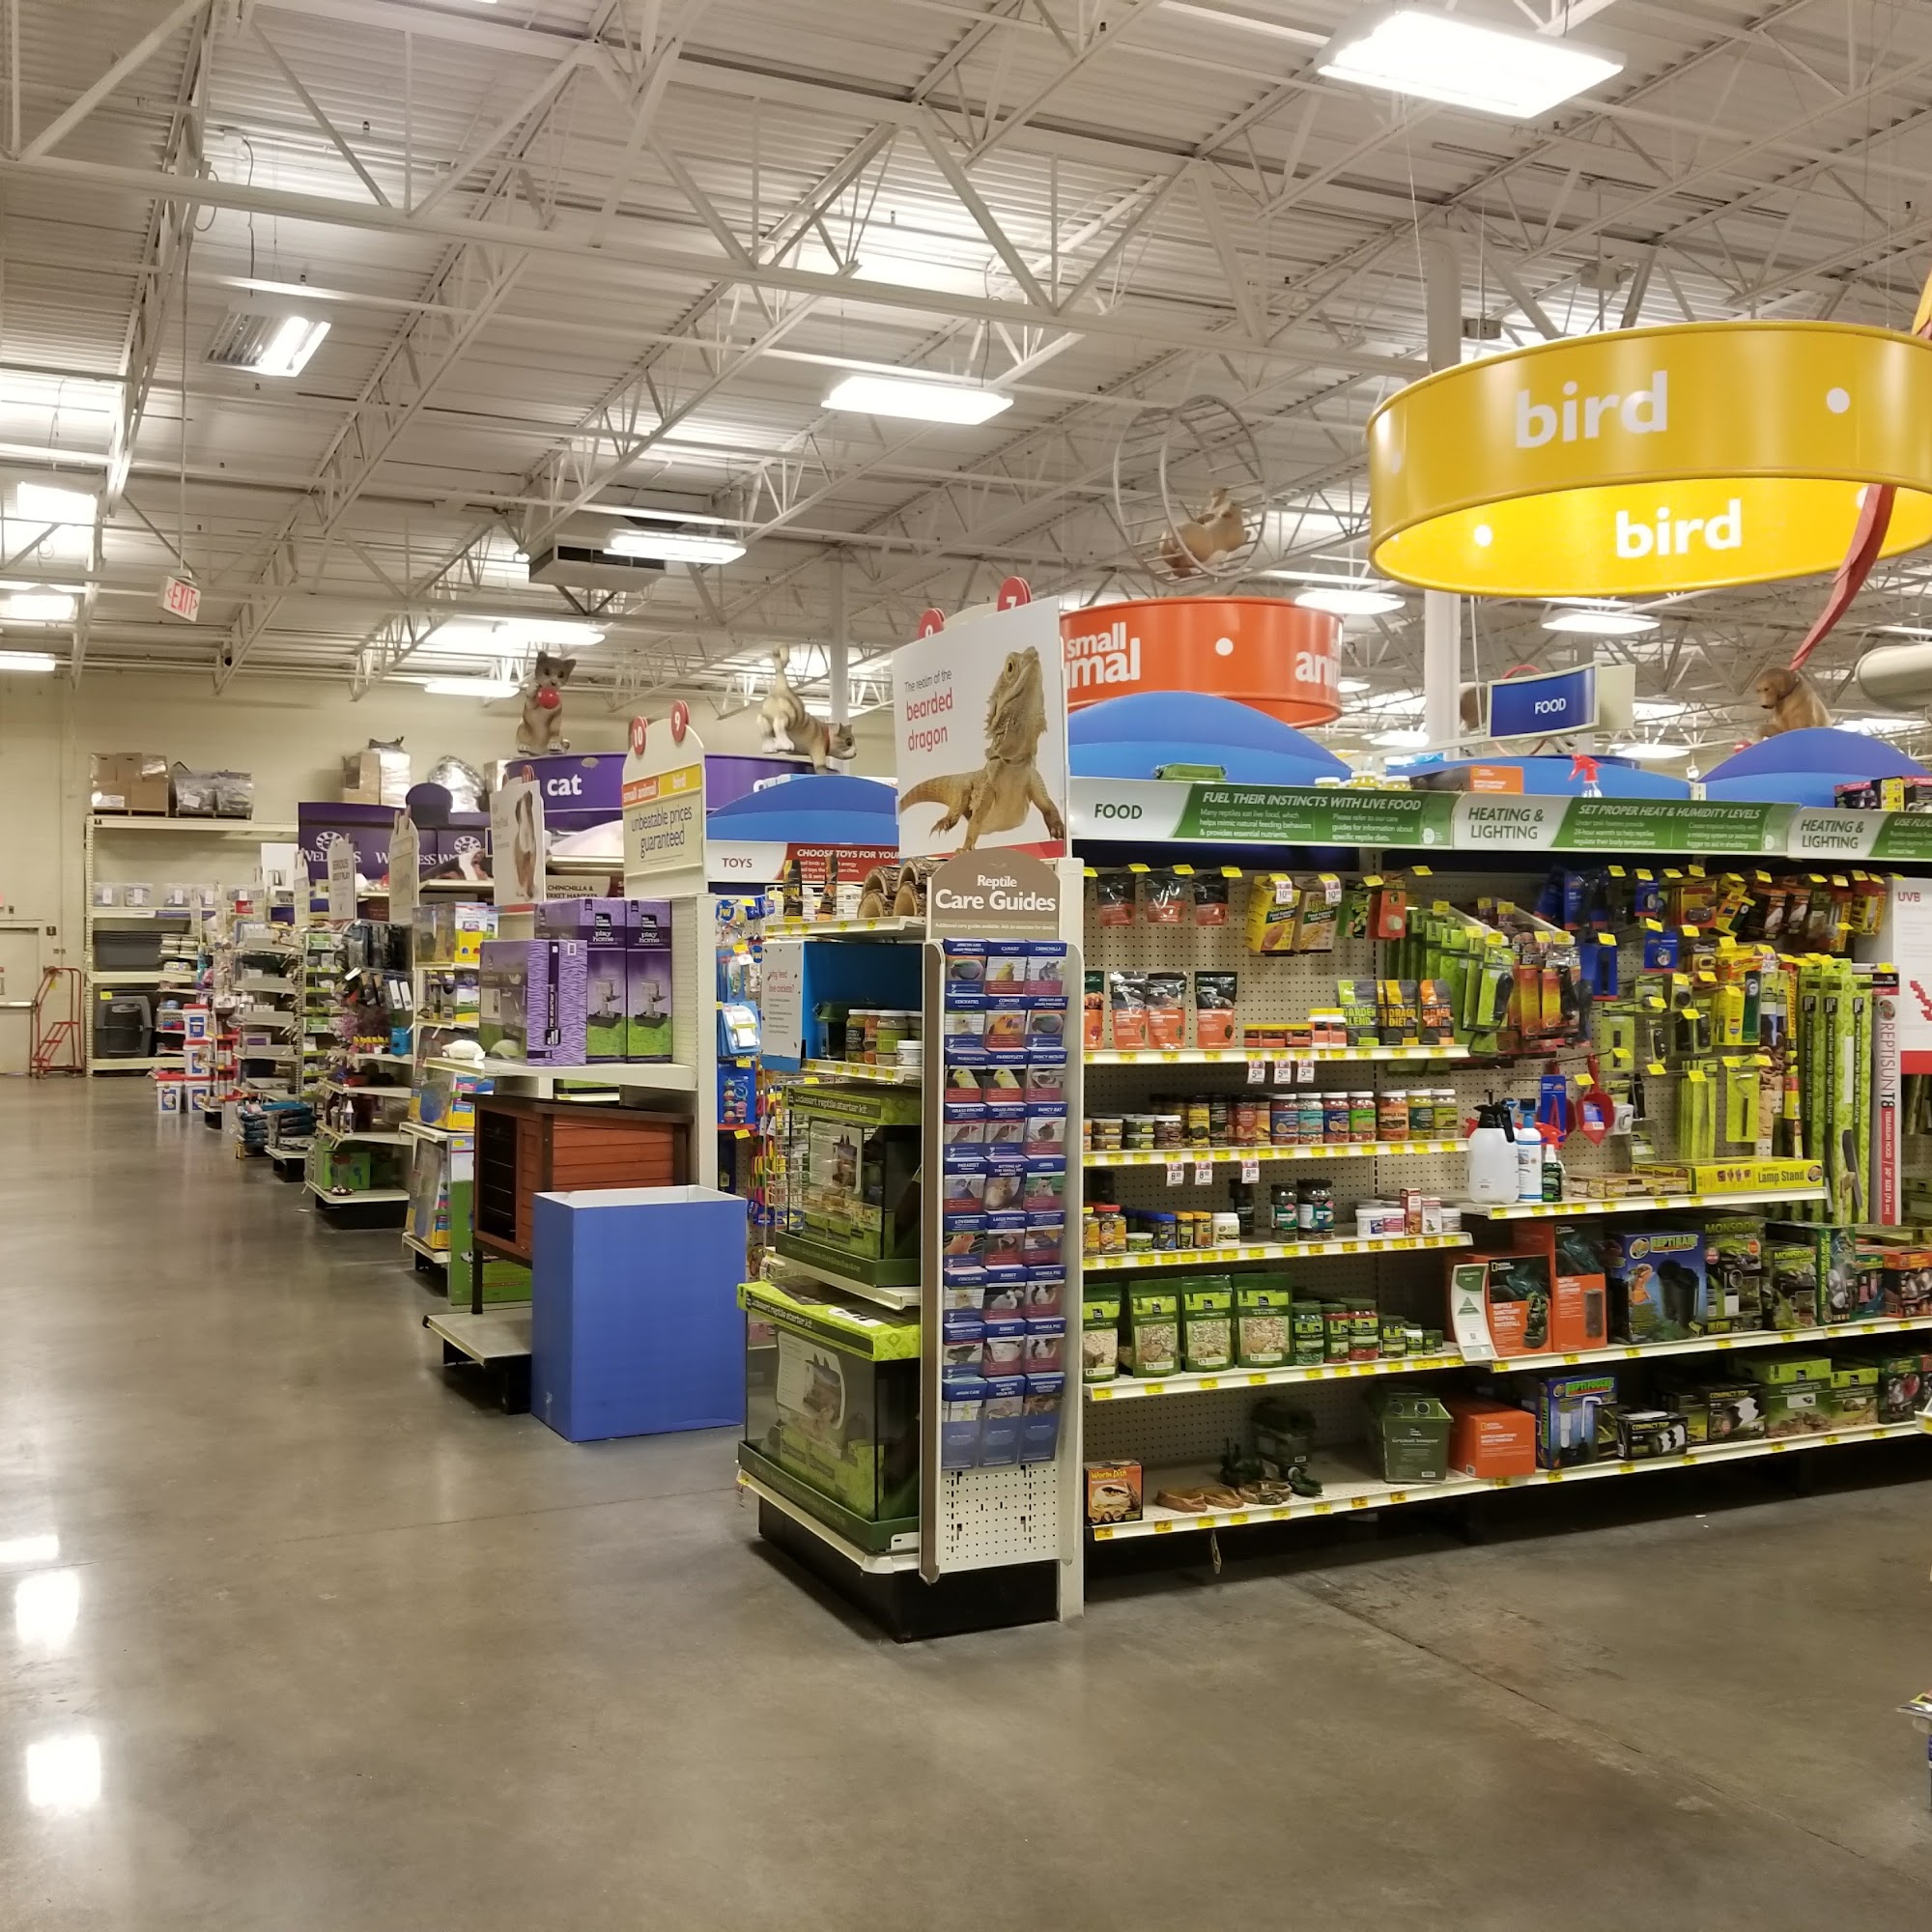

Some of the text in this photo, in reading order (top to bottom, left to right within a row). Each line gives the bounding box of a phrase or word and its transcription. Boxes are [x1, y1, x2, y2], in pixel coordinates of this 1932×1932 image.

[1515, 370, 1668, 448] bird
[1615, 498, 1743, 558] bird
[171, 582, 196, 615] EXIT
[1066, 622, 1126, 658] small
[904, 669, 952, 693] The realm of the
[906, 687, 953, 722] bearded
[1534, 696, 1568, 716] FOOD
[674, 711, 681, 731] 9
[634, 729, 643, 743] 10
[908, 725, 949, 753] dragon
[547, 774, 582, 796] cat
[671, 774, 687, 790] bird
[623, 780, 657, 803] small animal
[1203, 792, 1421, 810] FUEL THEIR INSTINCTS WITH LIVE FOOD
[631, 805, 693, 832] unbeatable prices
[1094, 803, 1143, 820] FOOD
[1468, 806, 1545, 822] HEATING &
[1578, 805, 1761, 820] SET PROPER HEAT & HUMIDITY LEVELS
[1801, 819, 1864, 833] HEATING &
[1893, 818, 1911, 827] USE
[1470, 824, 1539, 840] LIGHTING
[640, 824, 685, 859] guaranteed
[1802, 836, 1859, 849] LIGHTING
[796, 849, 835, 858] CHOOSE
[836, 850, 858, 859] TOYS
[859, 850, 877, 859] FOR
[722, 858, 753, 868] TOYS
[977, 874, 1018, 890] Reptile
[935, 889, 1057, 912] Care Guides
[1897, 891, 1921, 902] UVB
[1388, 1017, 1407, 1027] DIET
[1757, 1169, 1804, 1185] Lamp Stand
[1705, 1223, 1758, 1235] MONSOON
[1113, 1468, 1127, 1478] Dish
